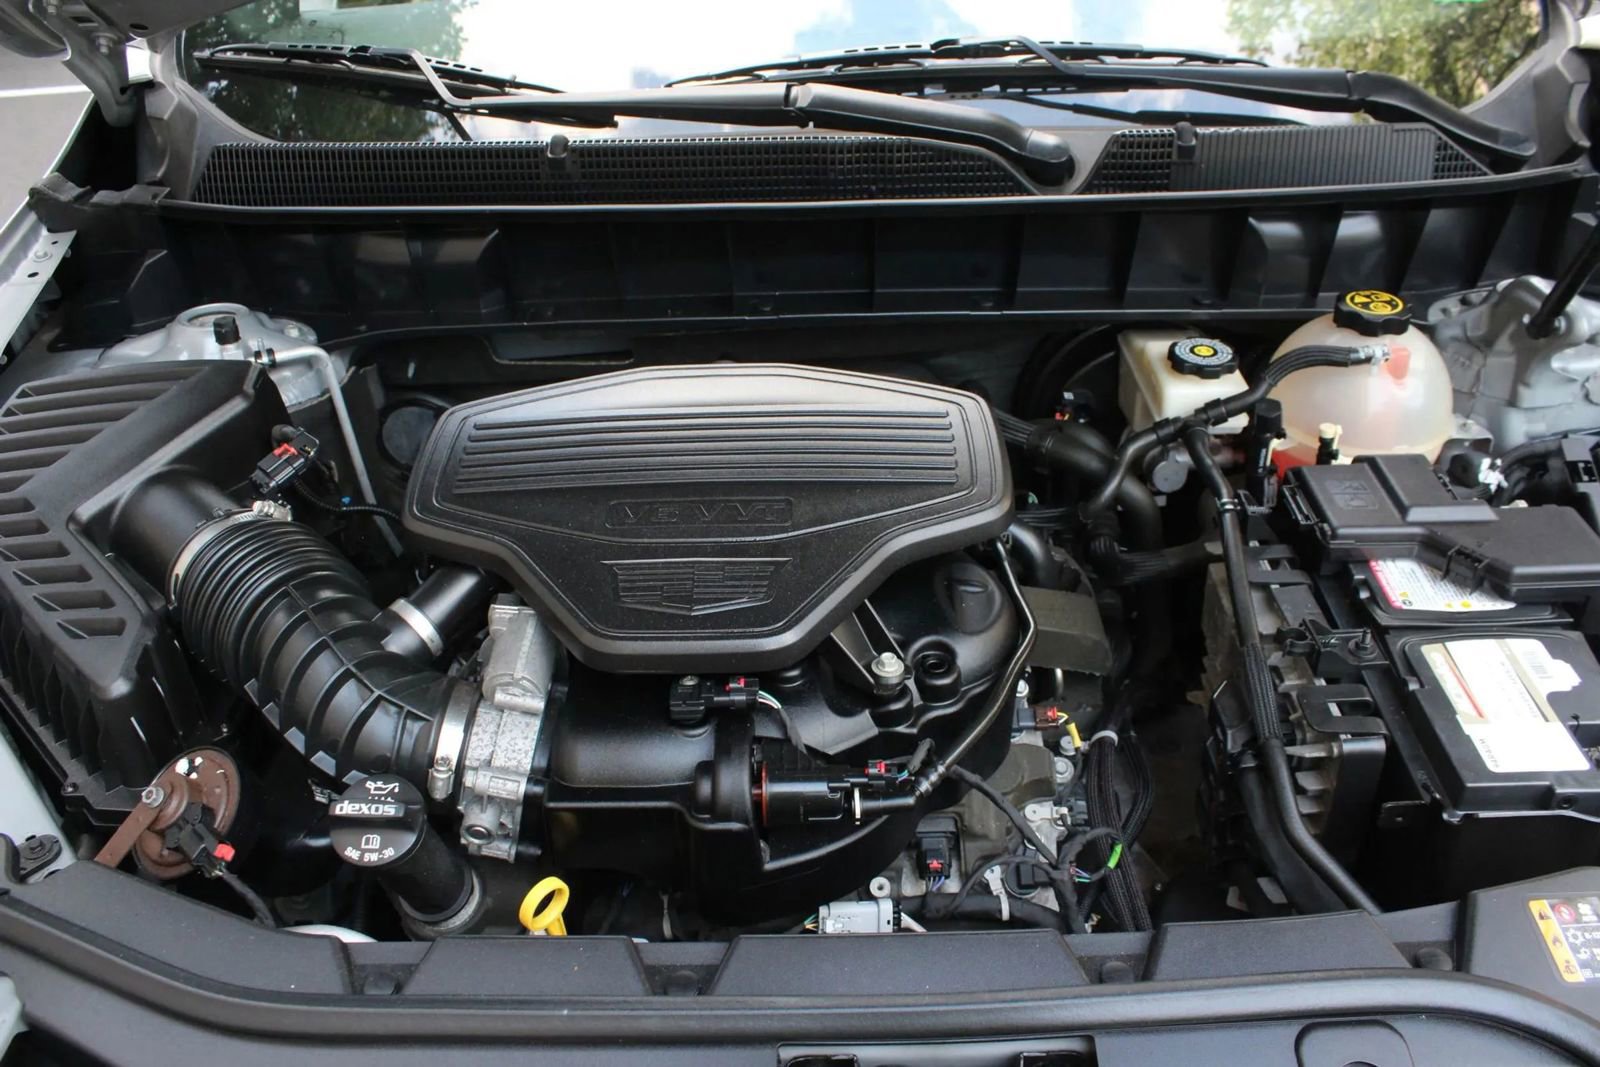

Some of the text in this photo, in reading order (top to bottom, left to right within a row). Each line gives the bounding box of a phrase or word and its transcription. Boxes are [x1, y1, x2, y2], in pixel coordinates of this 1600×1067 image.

[335, 800, 396, 815] dexos
[344, 846, 395, 862] SAE 5W-30
